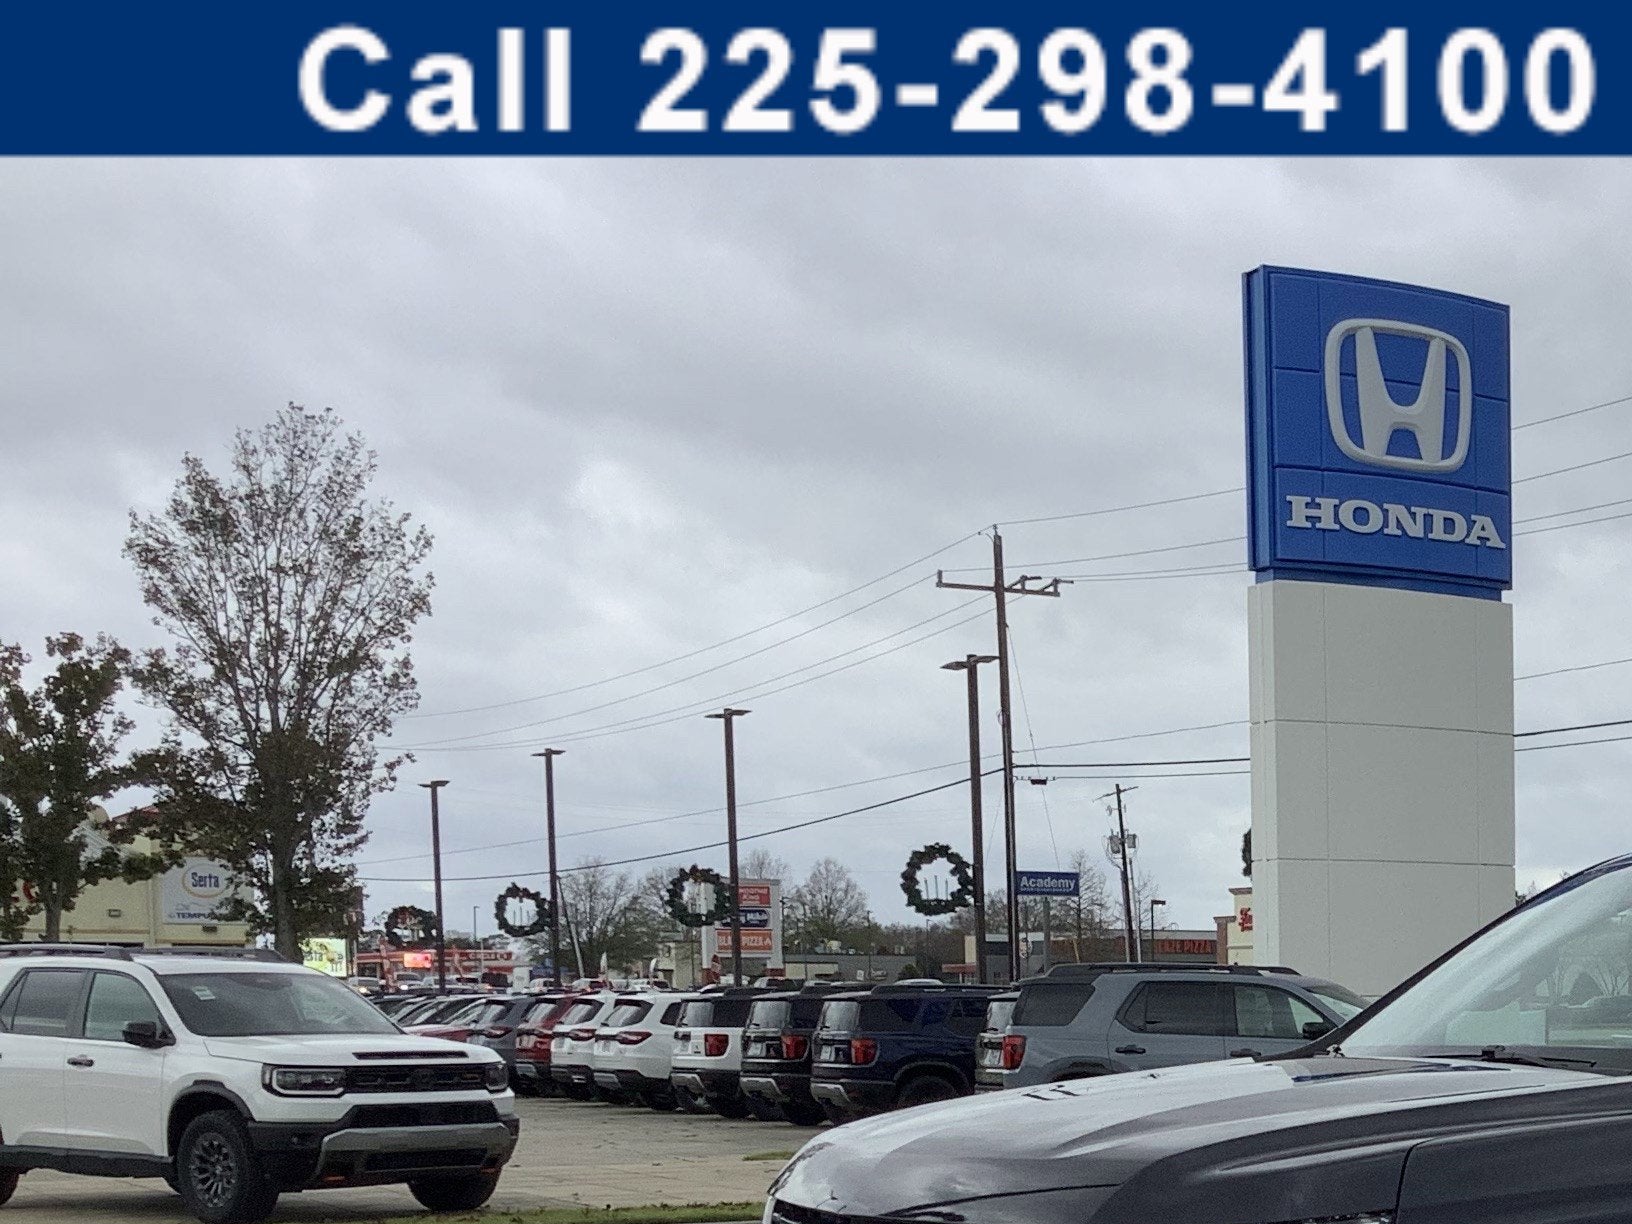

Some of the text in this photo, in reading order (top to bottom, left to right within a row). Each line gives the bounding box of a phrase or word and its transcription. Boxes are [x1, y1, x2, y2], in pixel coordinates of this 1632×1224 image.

[1286, 495, 1506, 549] HONDA
[191, 872, 220, 888] Serta
[1020, 876, 1076, 891] Academy
